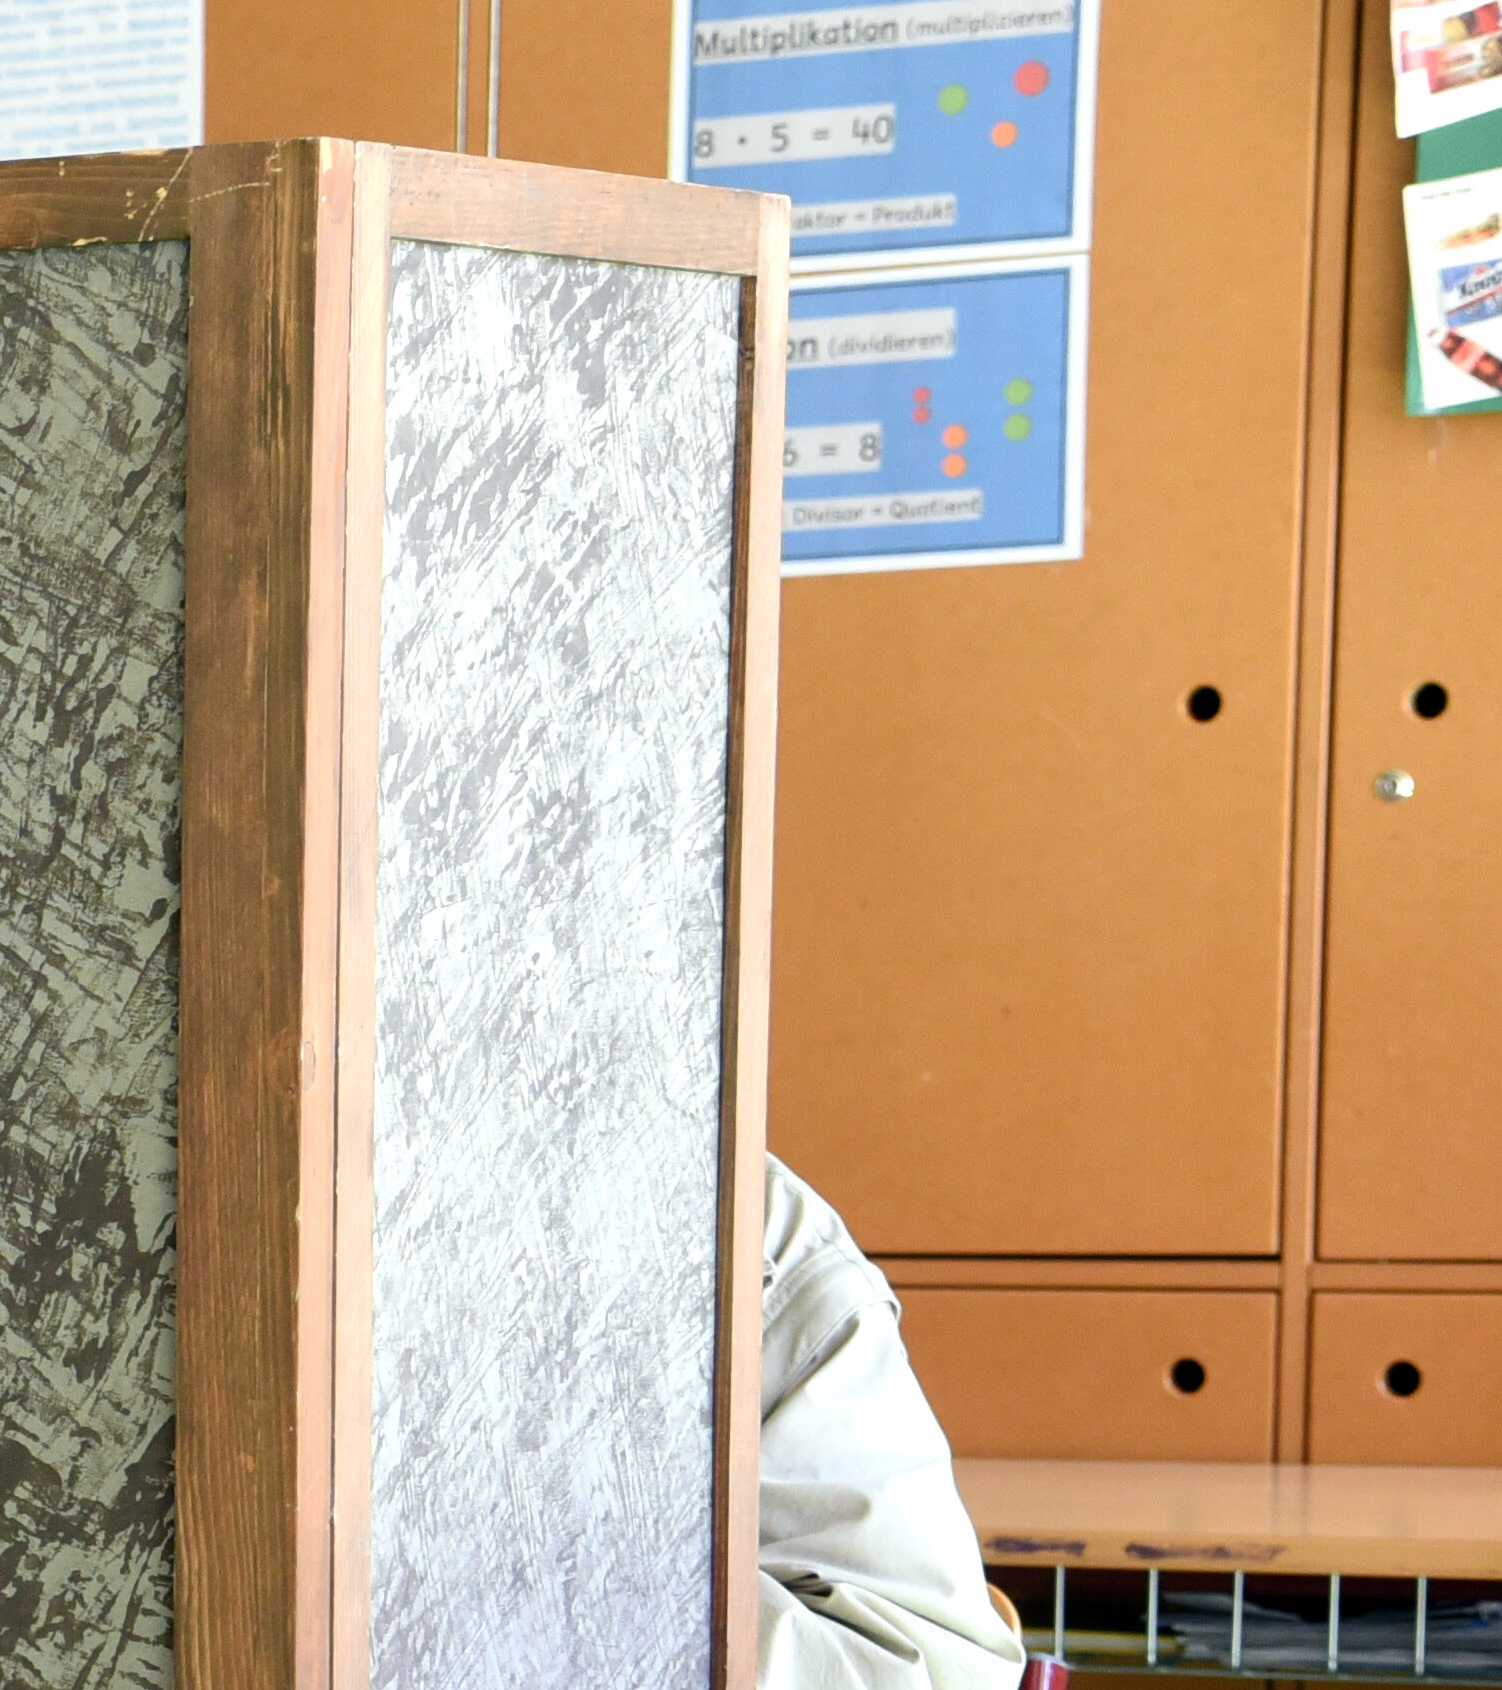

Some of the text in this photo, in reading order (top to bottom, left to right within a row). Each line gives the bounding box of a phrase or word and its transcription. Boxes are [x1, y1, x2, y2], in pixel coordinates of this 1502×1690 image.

[695, 19, 899, 56] Multiplikation
[696, 128, 715, 158] 8
[770, 121, 790, 152] 5
[852, 113, 895, 145] 40
[872, 200, 955, 225] Produkt
[828, 328, 954, 360] (dividieren)
[859, 432, 880, 462] 8
[793, 503, 862, 525] Divisor
[889, 497, 979, 520] Quotient
